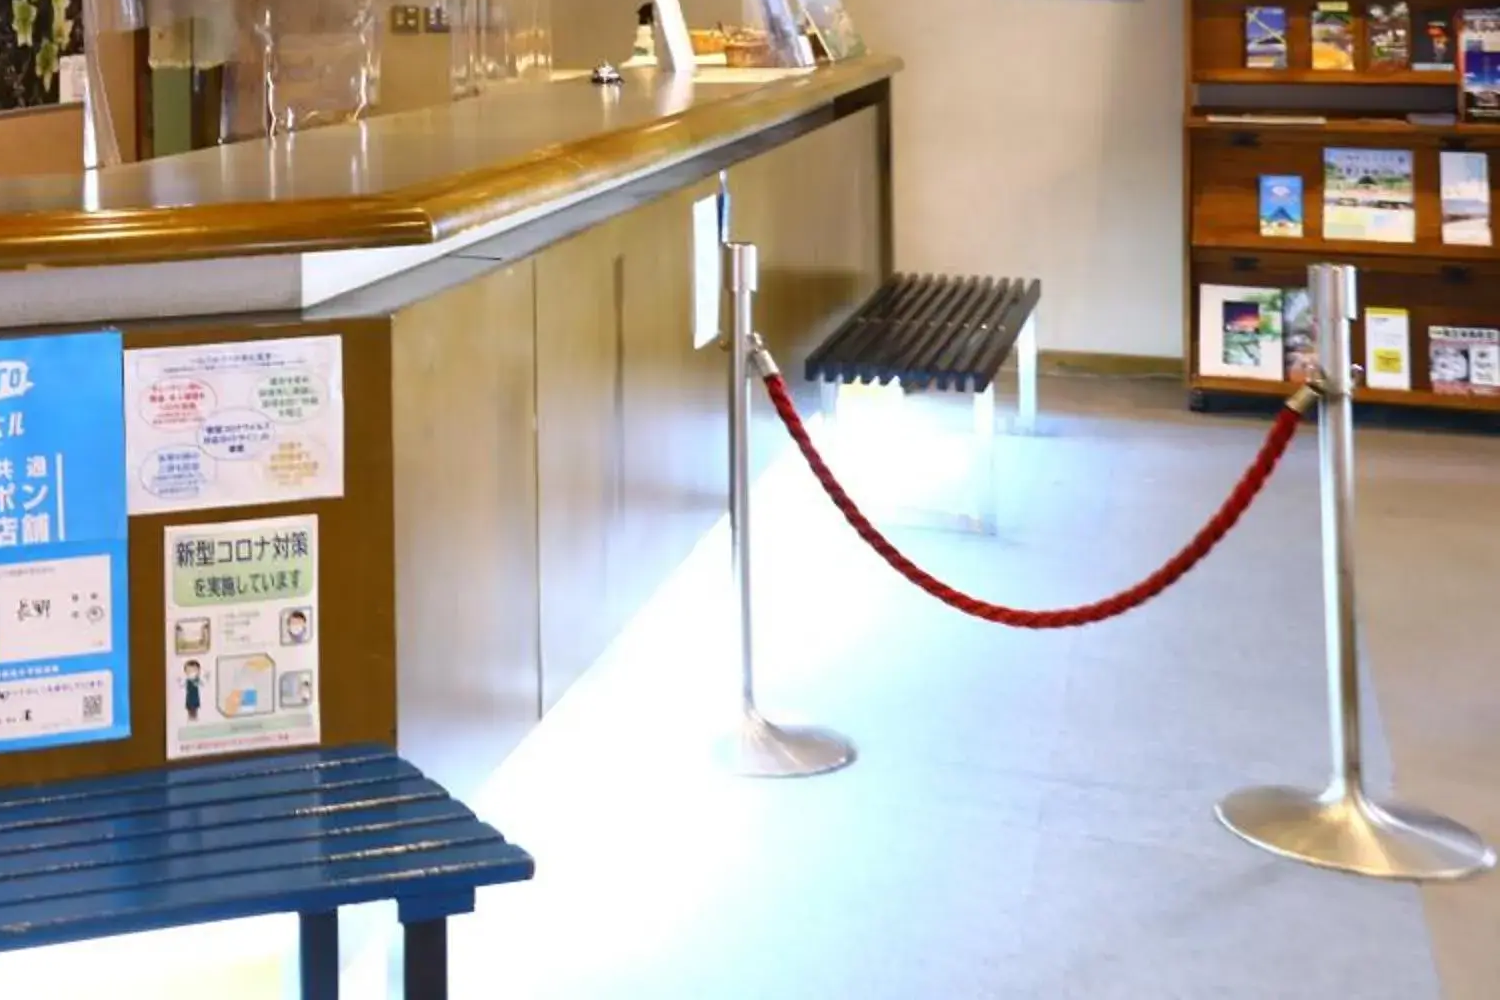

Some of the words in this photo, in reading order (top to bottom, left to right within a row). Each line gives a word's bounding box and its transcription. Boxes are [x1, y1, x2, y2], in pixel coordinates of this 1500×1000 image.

[175, 531, 309, 568] 新型コロナ対策
[193, 568, 302, 599] を実施しています
